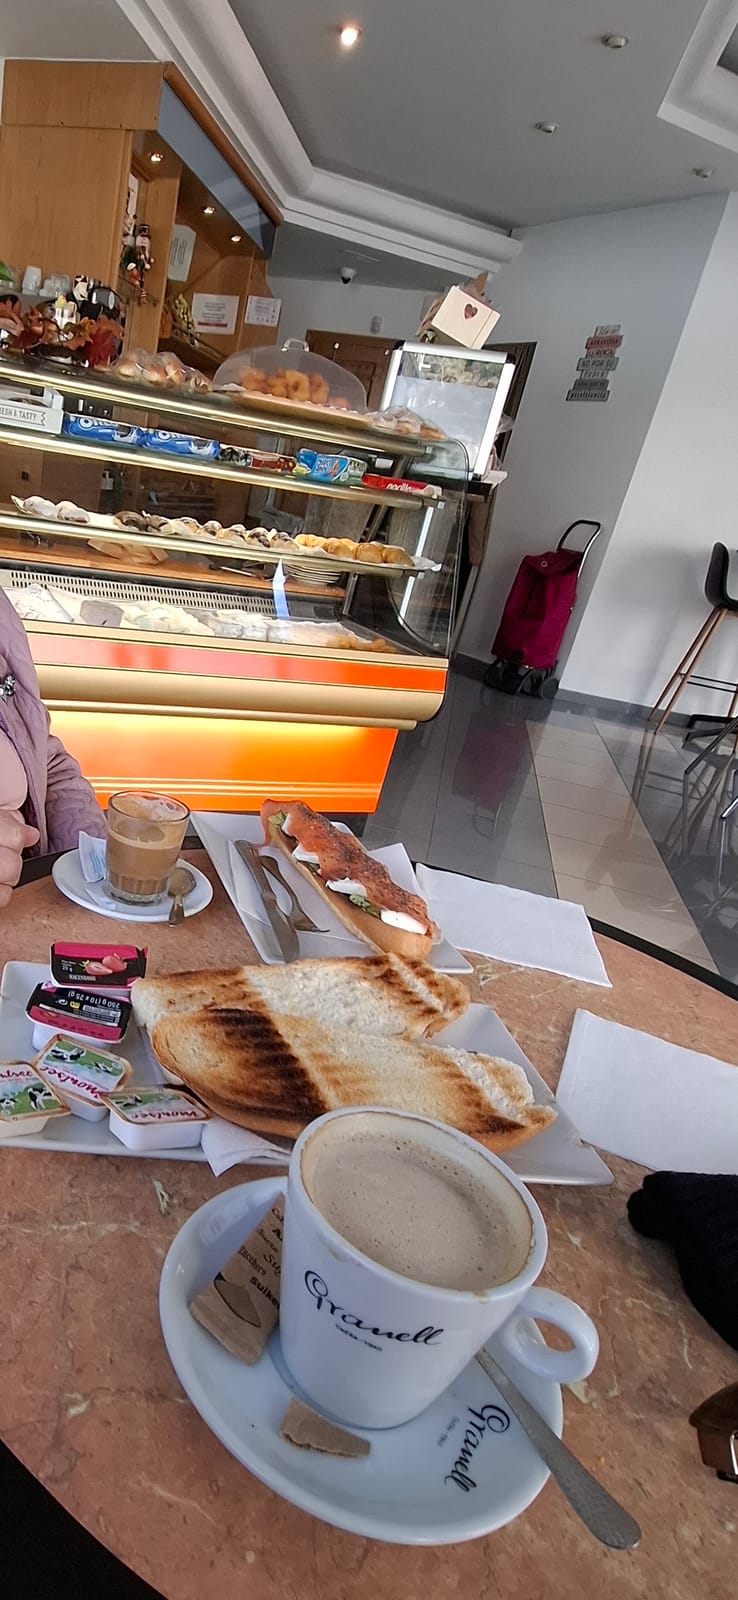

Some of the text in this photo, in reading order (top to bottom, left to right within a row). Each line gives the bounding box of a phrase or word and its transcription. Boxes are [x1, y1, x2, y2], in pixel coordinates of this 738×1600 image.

[581, 360, 591, 369] NO
[591, 360, 605, 368] POR
[0, 407, 12, 416] ESH
[18, 410, 37, 421] TASTY
[75, 993, 85, 1001] 25
[107, 1001, 121, 1009] 250
[304, 1270, 444, 1346] Granell
[443, 1404, 511, 1493] Granell
